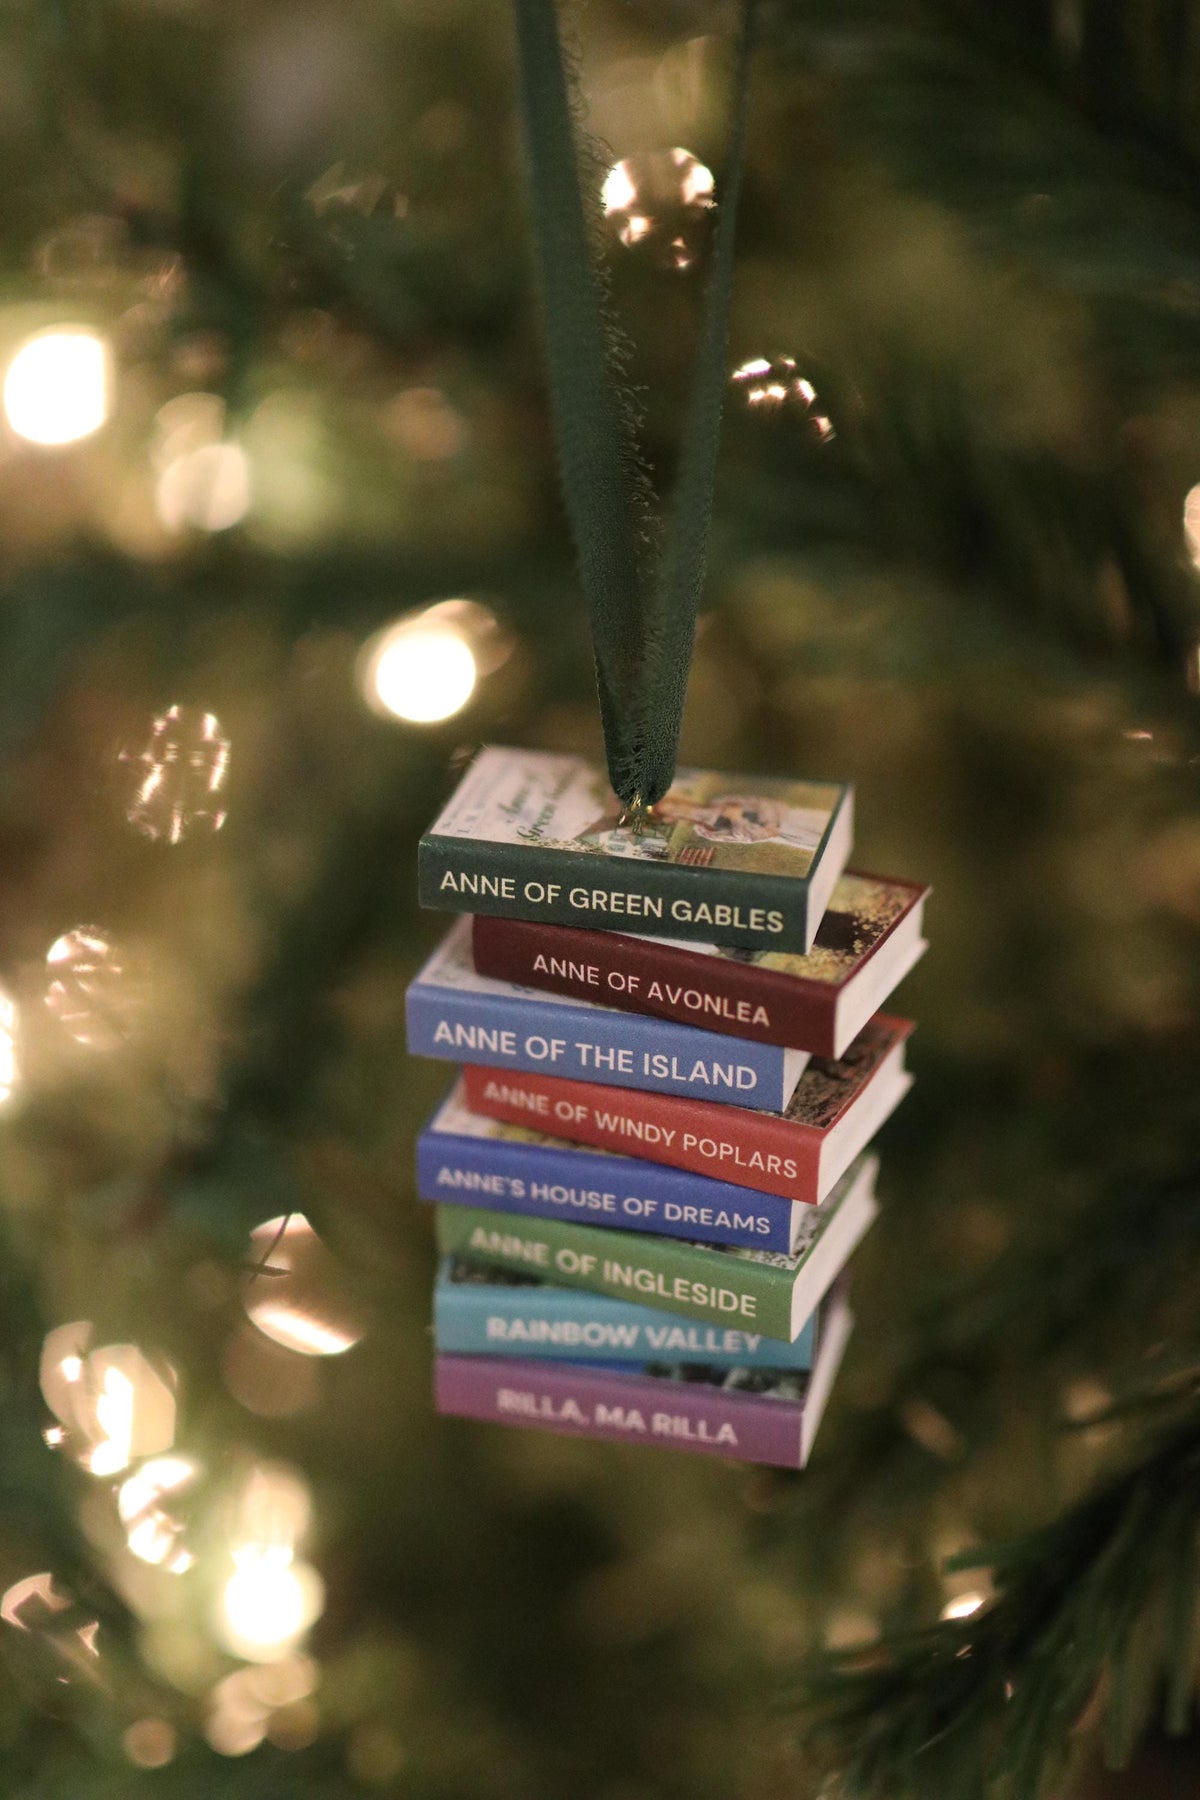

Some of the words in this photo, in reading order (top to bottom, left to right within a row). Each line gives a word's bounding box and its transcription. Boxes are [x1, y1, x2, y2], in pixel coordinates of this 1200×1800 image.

[440, 871, 515, 899] ANNE
[524, 882, 561, 904] OF
[569, 887, 662, 918] GREEN
[671, 900, 784, 933] GABLES
[533, 954, 600, 986] ANNE
[608, 970, 640, 995] OF
[648, 982, 770, 1028] AVONLEA
[433, 1021, 515, 1055] ANNE
[526, 1035, 566, 1061] OF
[575, 1043, 633, 1073] THE
[644, 1054, 757, 1090] ISLAND
[484, 1081, 548, 1114] ANNE
[556, 1101, 588, 1123] OF
[594, 1109, 676, 1148] WINDY
[683, 1134, 797, 1179] POPLARS
[437, 1167, 524, 1197] ANNE'S
[531, 1182, 615, 1212] HOUSE
[623, 1197, 656, 1217] OF
[664, 1203, 770, 1235] DREAMS
[470, 1227, 548, 1264] ANNE
[555, 1249, 598, 1277] OF
[604, 1260, 756, 1318] INGLESIDE
[487, 1317, 639, 1348] RAINBOW
[645, 1324, 762, 1354] VALLEY
[497, 1388, 589, 1424] RILLA,
[595, 1404, 647, 1432] MA
[653, 1413, 738, 1446] RILLA
